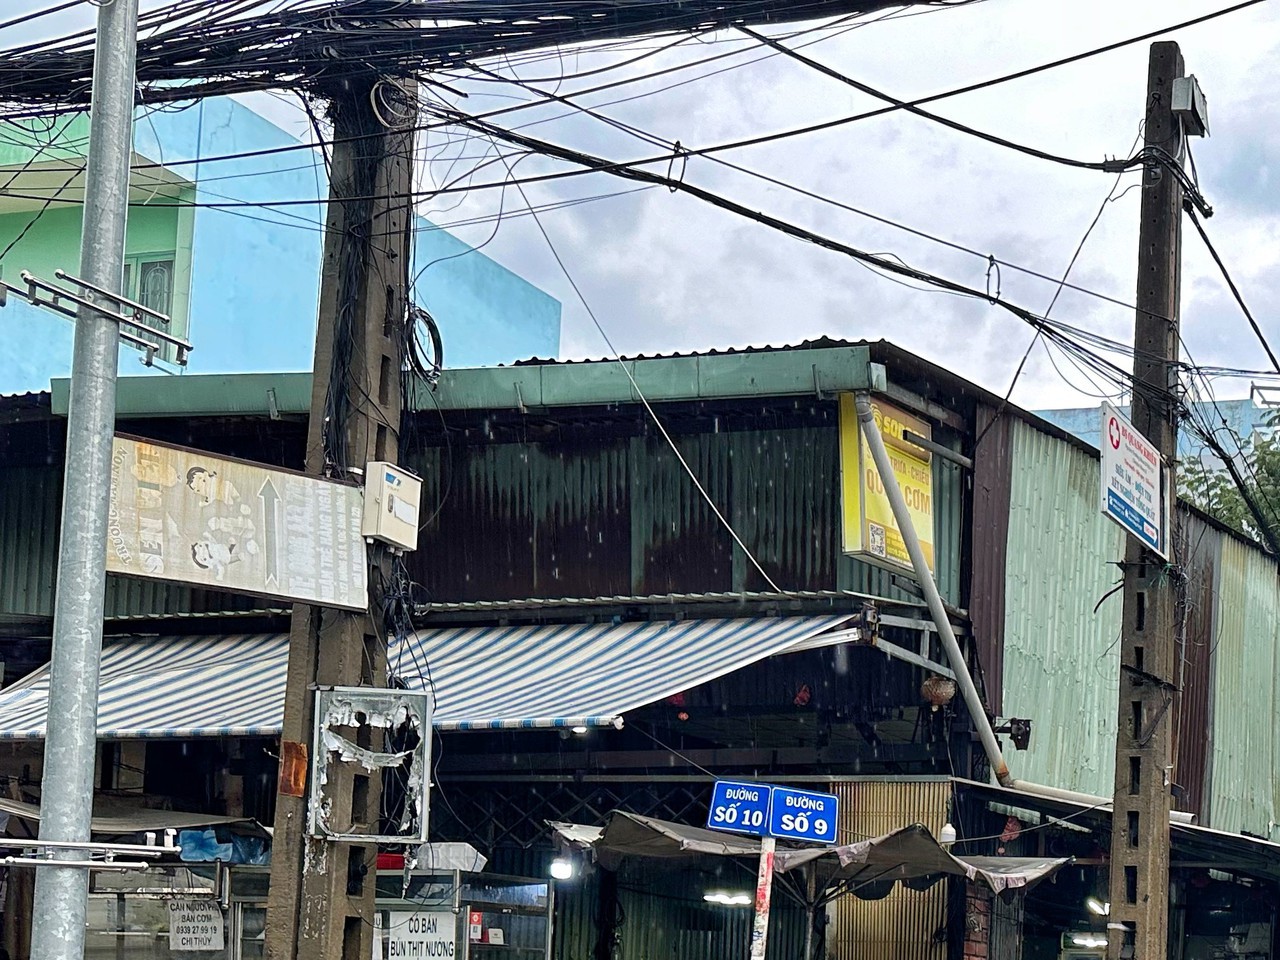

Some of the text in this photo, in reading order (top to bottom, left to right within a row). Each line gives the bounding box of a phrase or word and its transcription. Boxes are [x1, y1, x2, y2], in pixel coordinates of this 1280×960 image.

[904, 484, 931, 515] CƠM
[725, 787, 758, 801] ĐƯỜNG
[786, 796, 824, 811] ĐƯỜNG
[713, 802, 763, 826] SỐ 10
[781, 811, 828, 835] SỐ 9
[176, 925, 191, 935] 0939
[192, 925, 200, 935] 27
[200, 925, 209, 935] 99
[408, 914, 437, 934] CÓ BÁN
[390, 937, 454, 960] BÚN THỊT NƯỚNG
